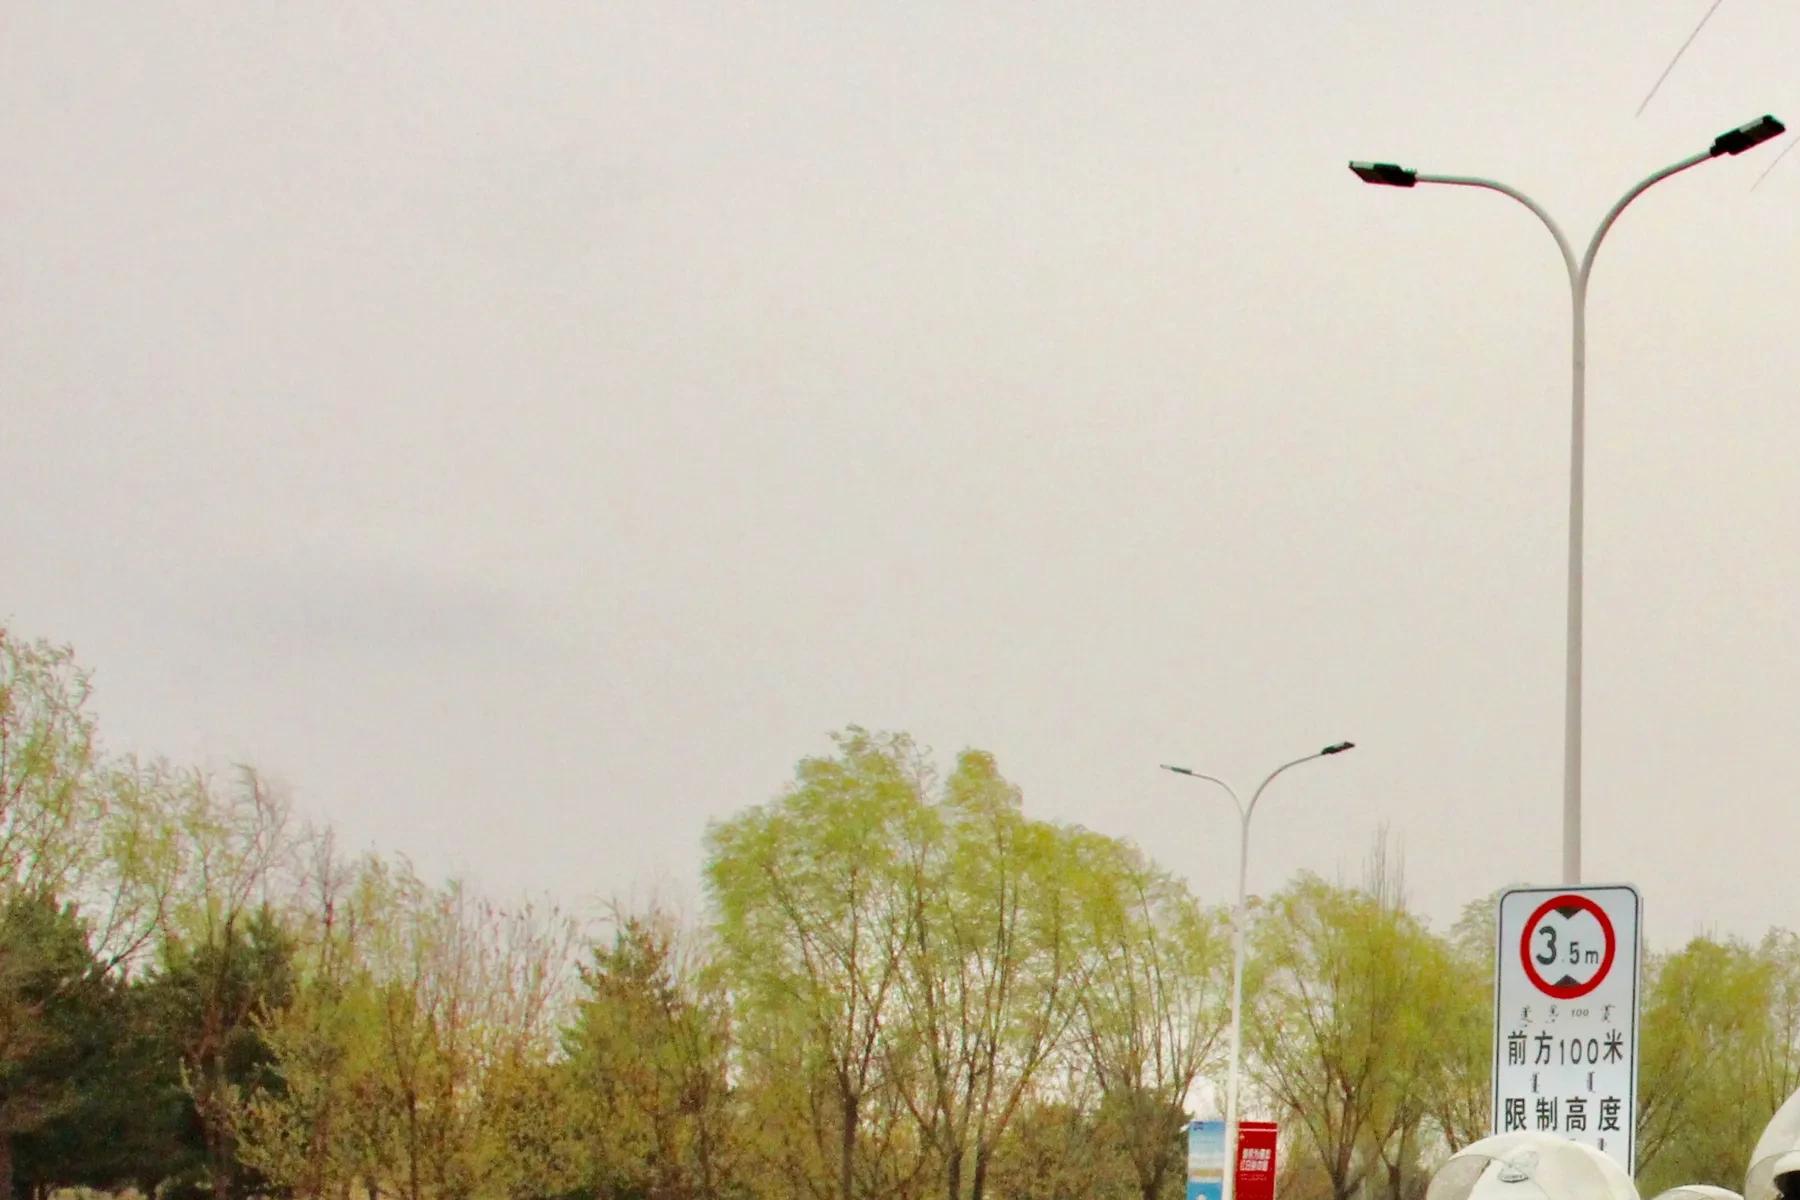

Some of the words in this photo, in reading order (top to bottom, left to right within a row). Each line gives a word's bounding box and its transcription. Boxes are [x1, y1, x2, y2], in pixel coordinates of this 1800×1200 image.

[1507, 1028, 1623, 1066] 前方100米
[1504, 1096, 1621, 1132] 限制高度
